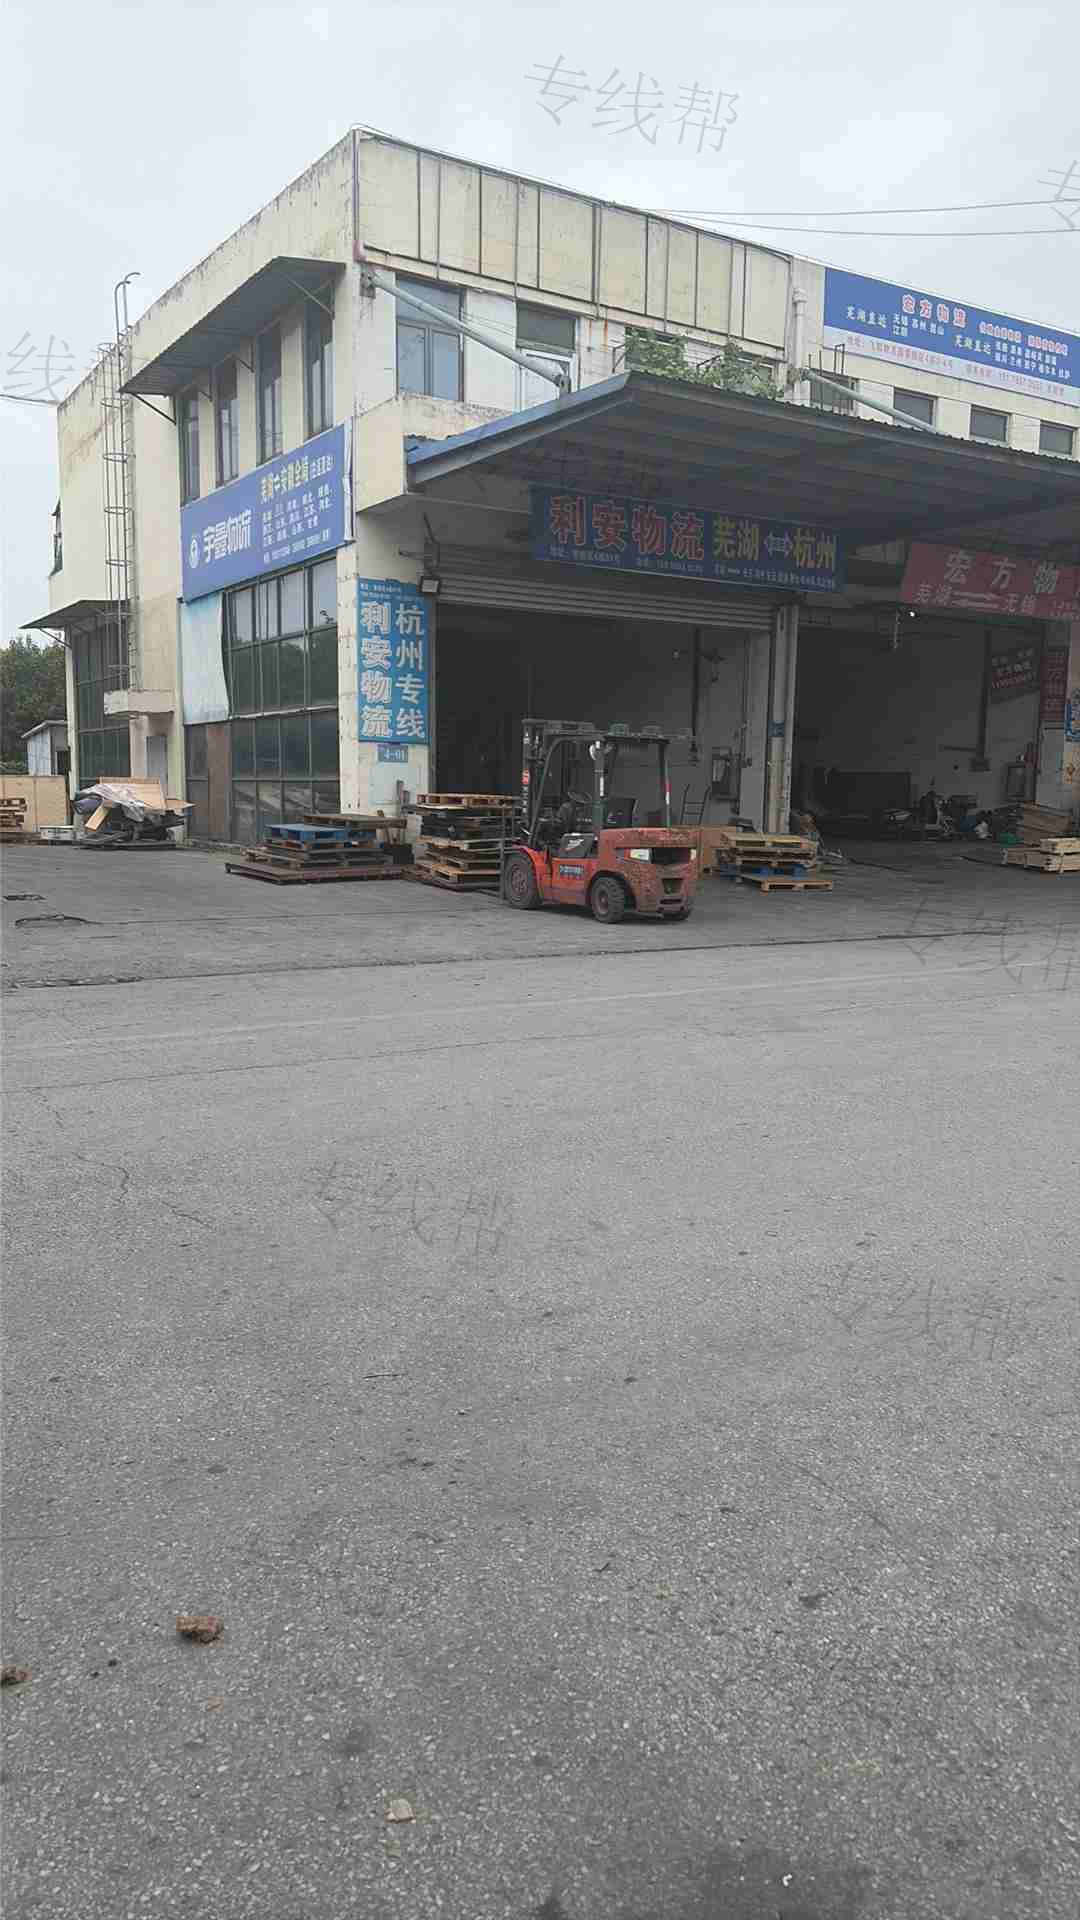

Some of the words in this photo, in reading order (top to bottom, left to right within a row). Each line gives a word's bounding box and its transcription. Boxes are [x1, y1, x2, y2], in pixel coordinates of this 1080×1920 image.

[551, 496, 705, 561] 利安物流
[713, 515, 760, 561] 芜湖
[793, 527, 838, 571] 杭州
[360, 601, 392, 737] 利安物流
[395, 603, 425, 738] 杭州专线
